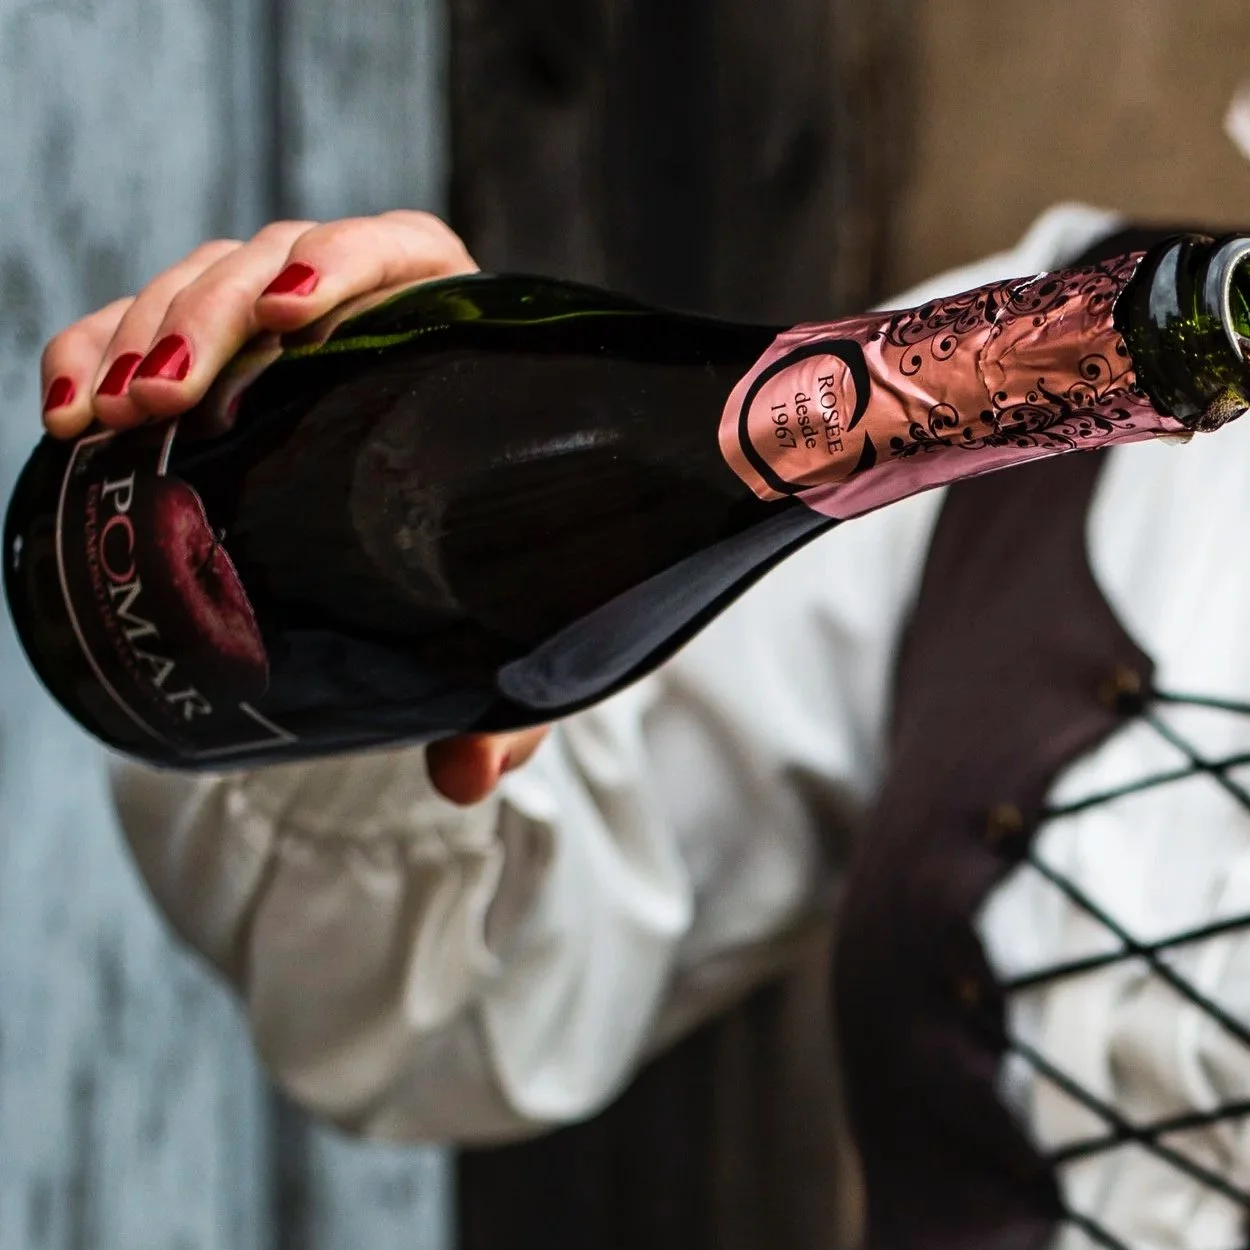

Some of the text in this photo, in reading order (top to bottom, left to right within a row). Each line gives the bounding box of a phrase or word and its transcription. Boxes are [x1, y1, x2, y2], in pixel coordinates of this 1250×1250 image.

[771, 402, 797, 449] 1967
[794, 392, 819, 449] desde
[818, 373, 844, 455] ROSÉE
[101, 471, 212, 721] POMAR
